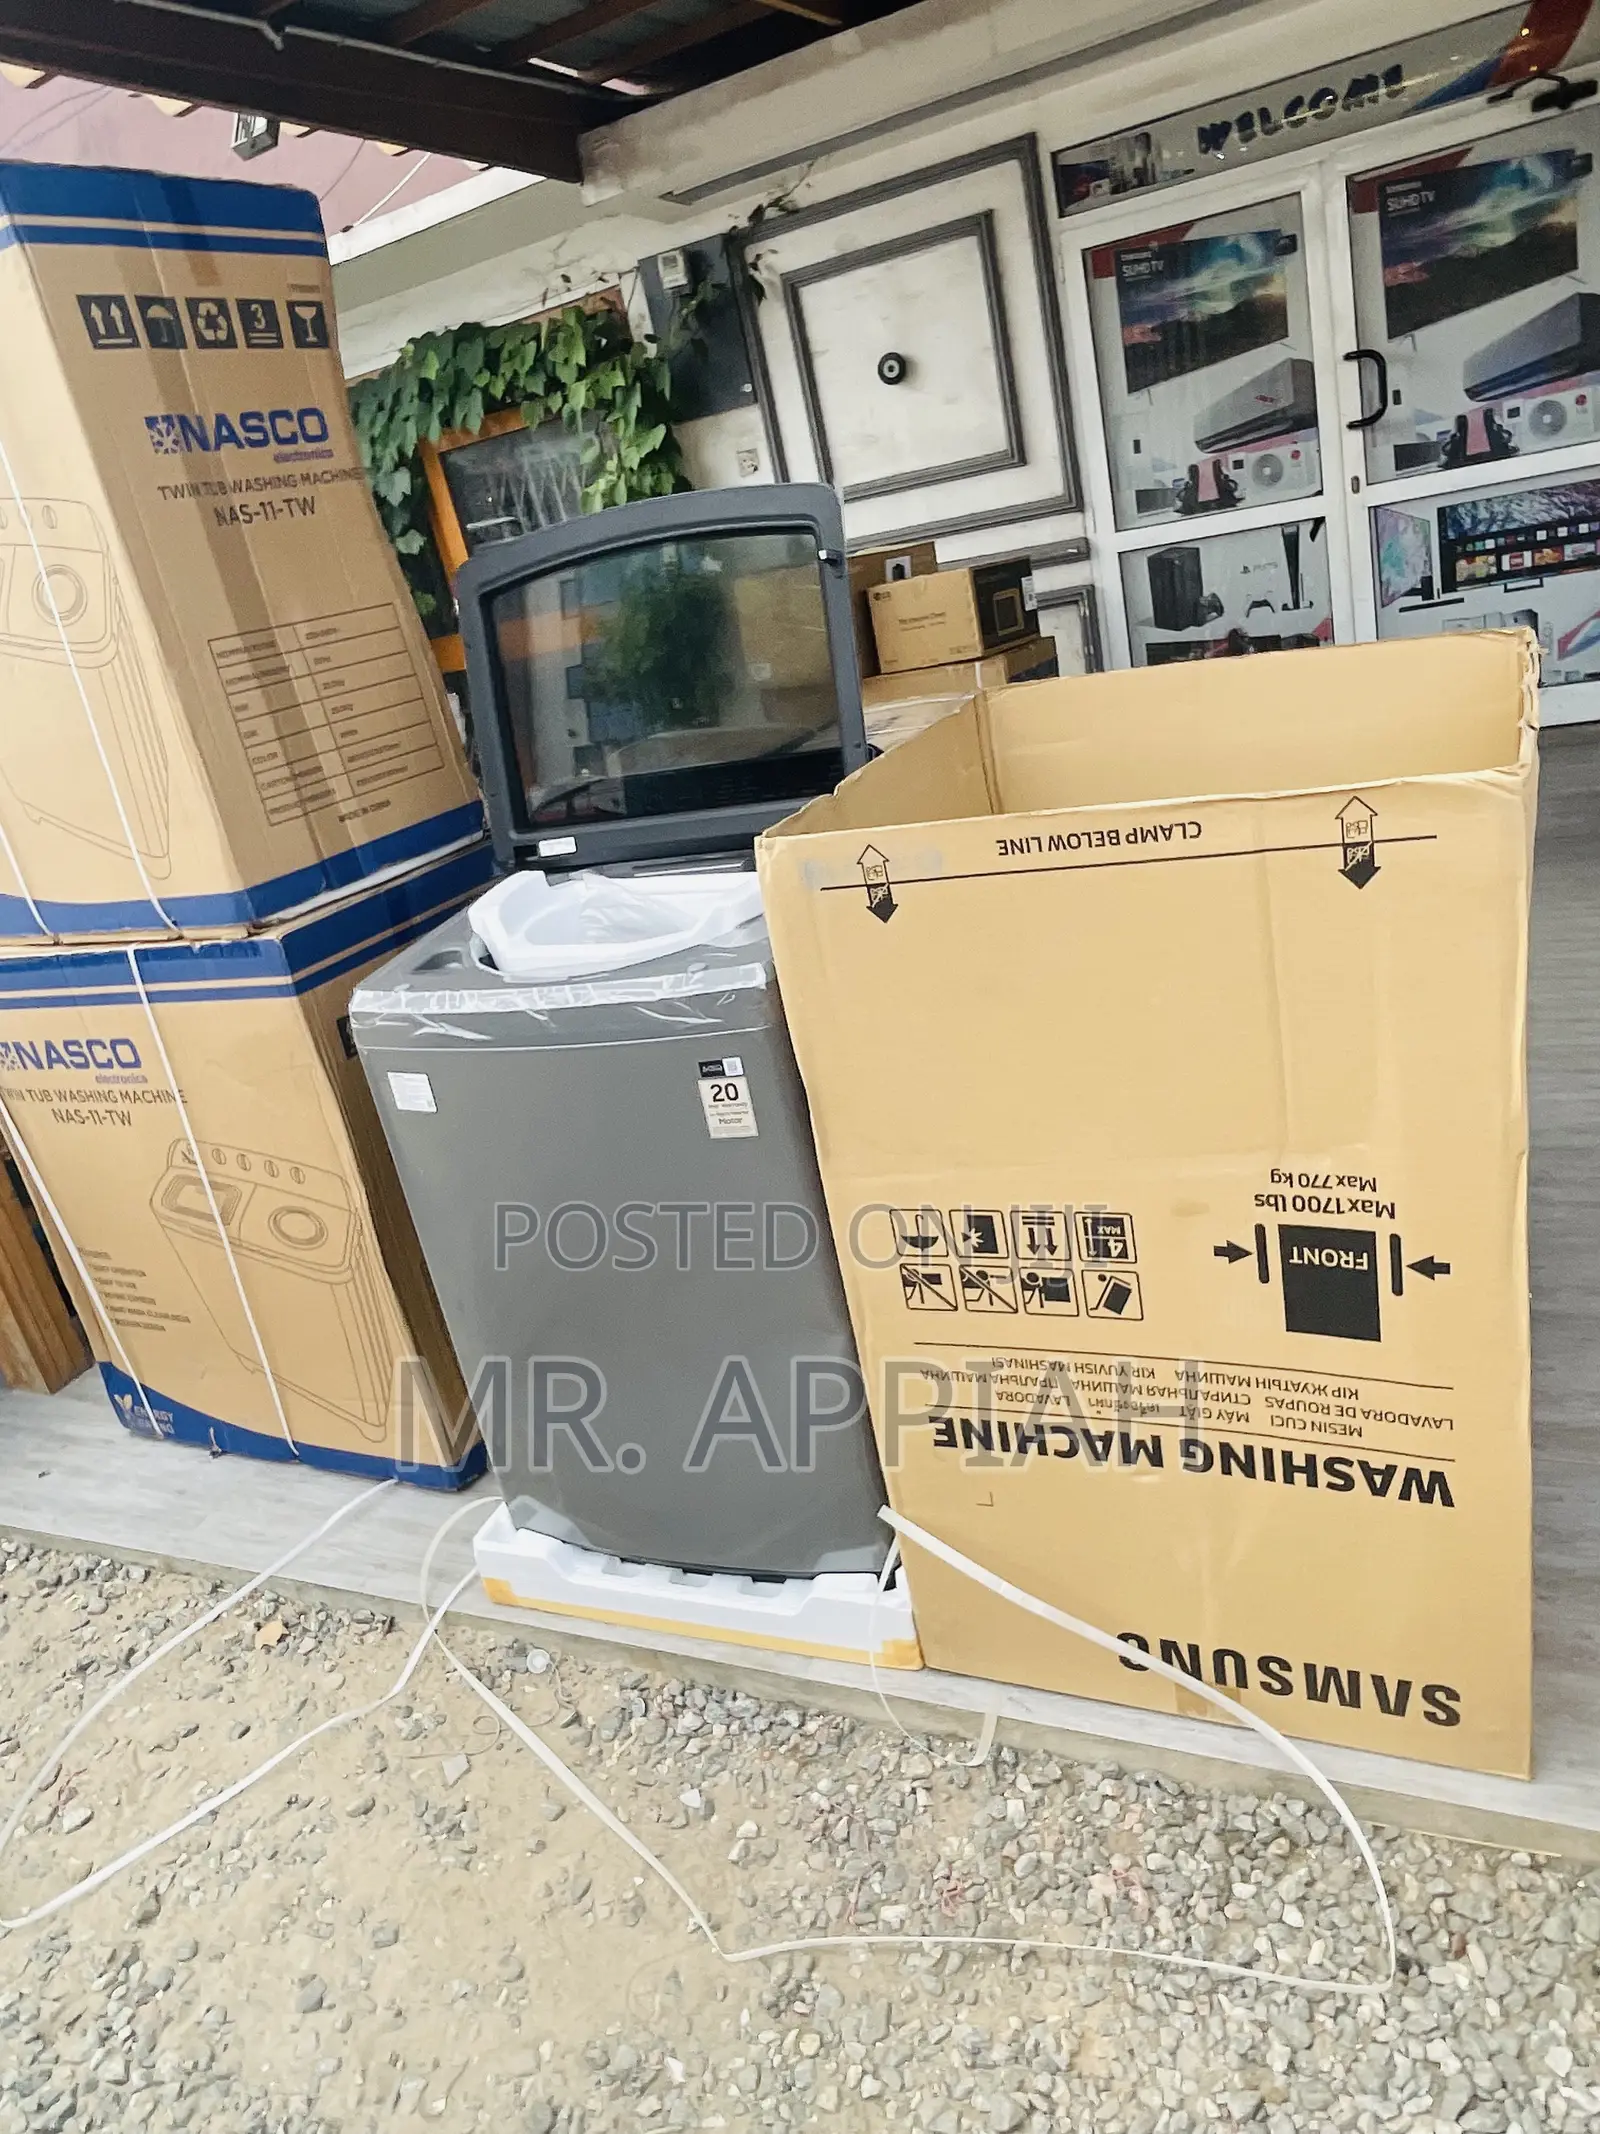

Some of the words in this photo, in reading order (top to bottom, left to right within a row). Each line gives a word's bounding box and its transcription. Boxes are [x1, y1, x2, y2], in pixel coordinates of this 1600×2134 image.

[1197, 64, 1406, 154] WELCOME
[176, 407, 329, 453] NASCO
[230, 473, 298, 494] WASHING
[213, 496, 316, 526] NAS-11-TW
[1047, 829, 1122, 851] BELOW
[1125, 821, 1203, 846] CLAMP
[997, 838, 1043, 855] LINE
[12, 1038, 142, 1070] NASCO
[25, 1089, 53, 1102] TUB
[53, 1089, 118, 1104] WASHING
[119, 1089, 188, 1104] MACHINE
[711, 1083, 739, 1102] 20
[51, 1108, 133, 1127] NAS-11-TW
[1270, 1169, 1294, 1188] kg
[1254, 1193, 1287, 1213] lbs
[1107, 1239, 1123, 1257] 4
[1289, 1246, 1370, 1270] FRONT
[992, 1357, 1071, 1373] MASHINASI
[1074, 1362, 1129, 1377] YUVISH
[1131, 1366, 1156, 1380] KIR
[920, 1369, 987, 1385] МАШИНА
[1175, 1370, 1251, 1389] МАШИНА
[1071, 1379, 1143, 1396] МАШИНА
[1144, 1384, 1251, 1406] СТИРАЛЬНАЯ
[995, 1390, 1071, 1408] LAVADORA
[1265, 1396, 1331, 1416] ROUPAS
[1217, 1408, 1250, 1427] MÁY
[1335, 1404, 1357, 1418] DE
[1360, 1408, 1454, 1431] LAVADORA
[1270, 1415, 1307, 1433] CUCI
[1310, 1420, 1363, 1438] MESIN
[930, 1415, 1165, 1468] MACHINE
[1179, 1438, 1455, 1507] WASHING
